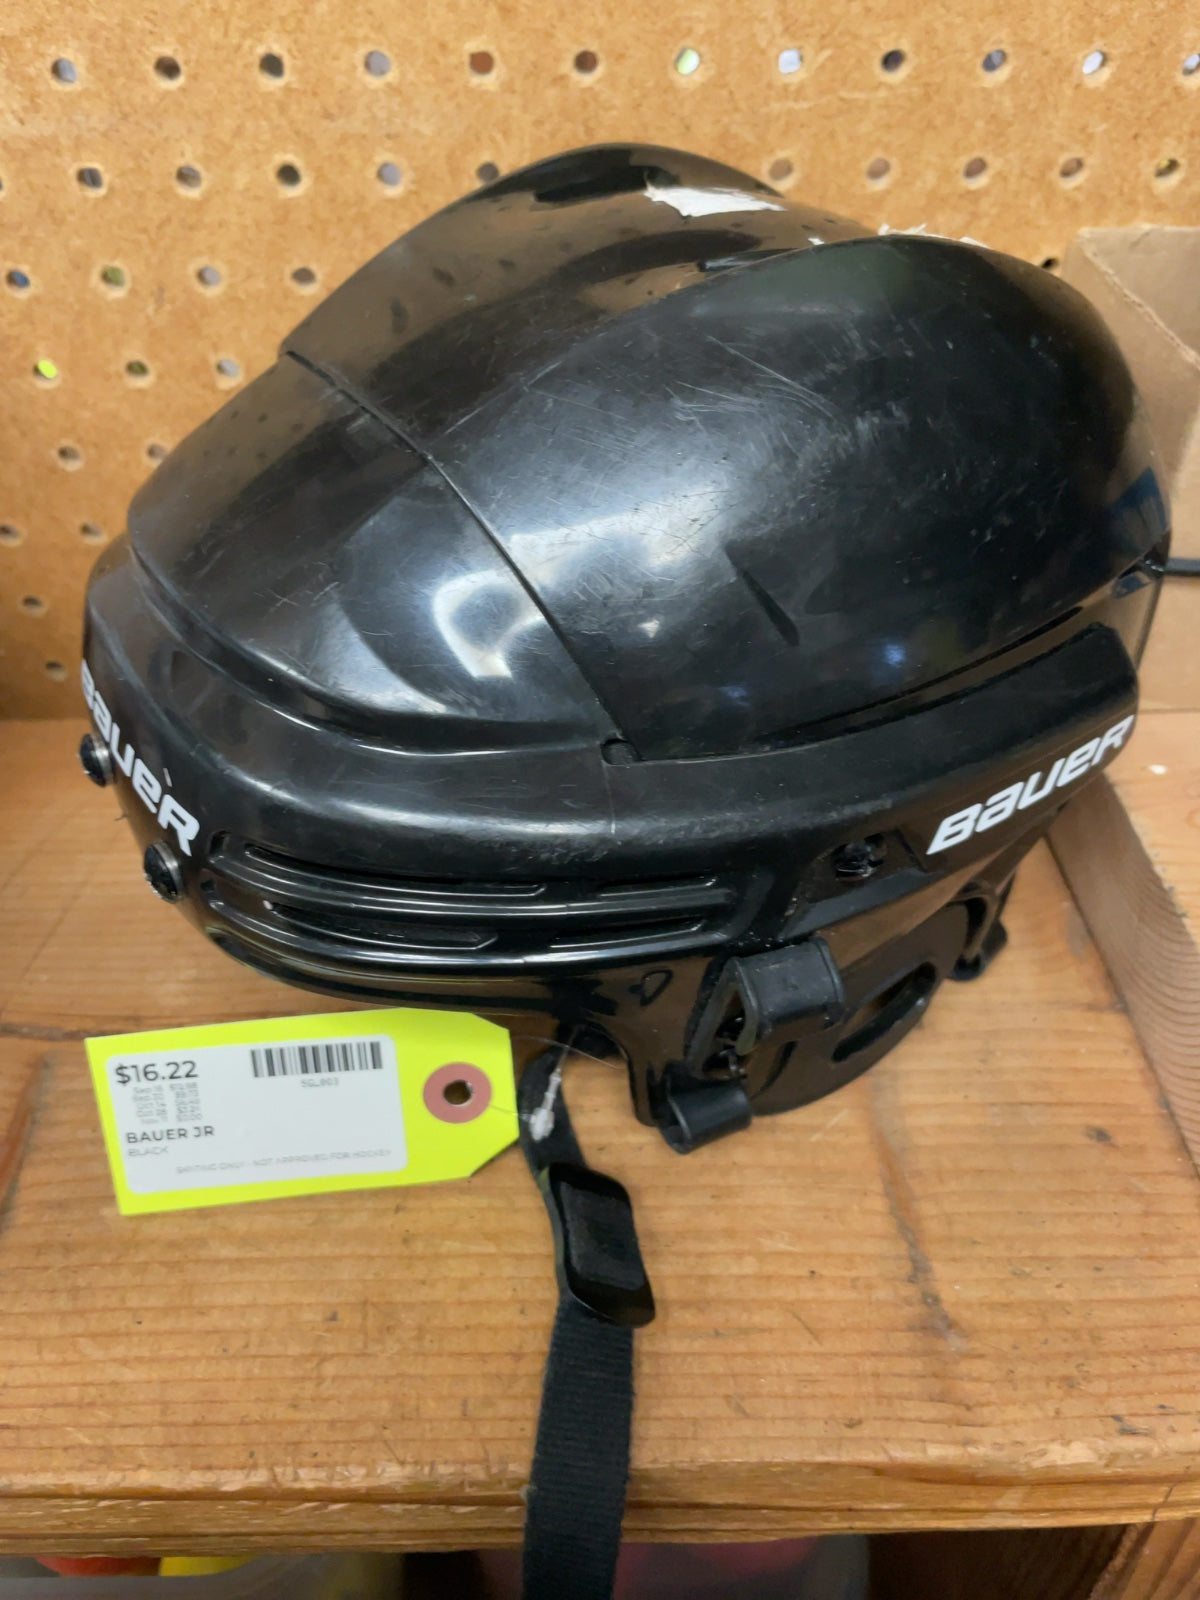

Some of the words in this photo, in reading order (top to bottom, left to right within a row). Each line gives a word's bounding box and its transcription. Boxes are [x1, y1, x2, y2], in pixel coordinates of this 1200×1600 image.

[115, 1060, 199, 1086] $16.22
[127, 1128, 188, 1144] BAUER
[193, 1125, 215, 1138] JR
[127, 1146, 168, 1157] BLACK
